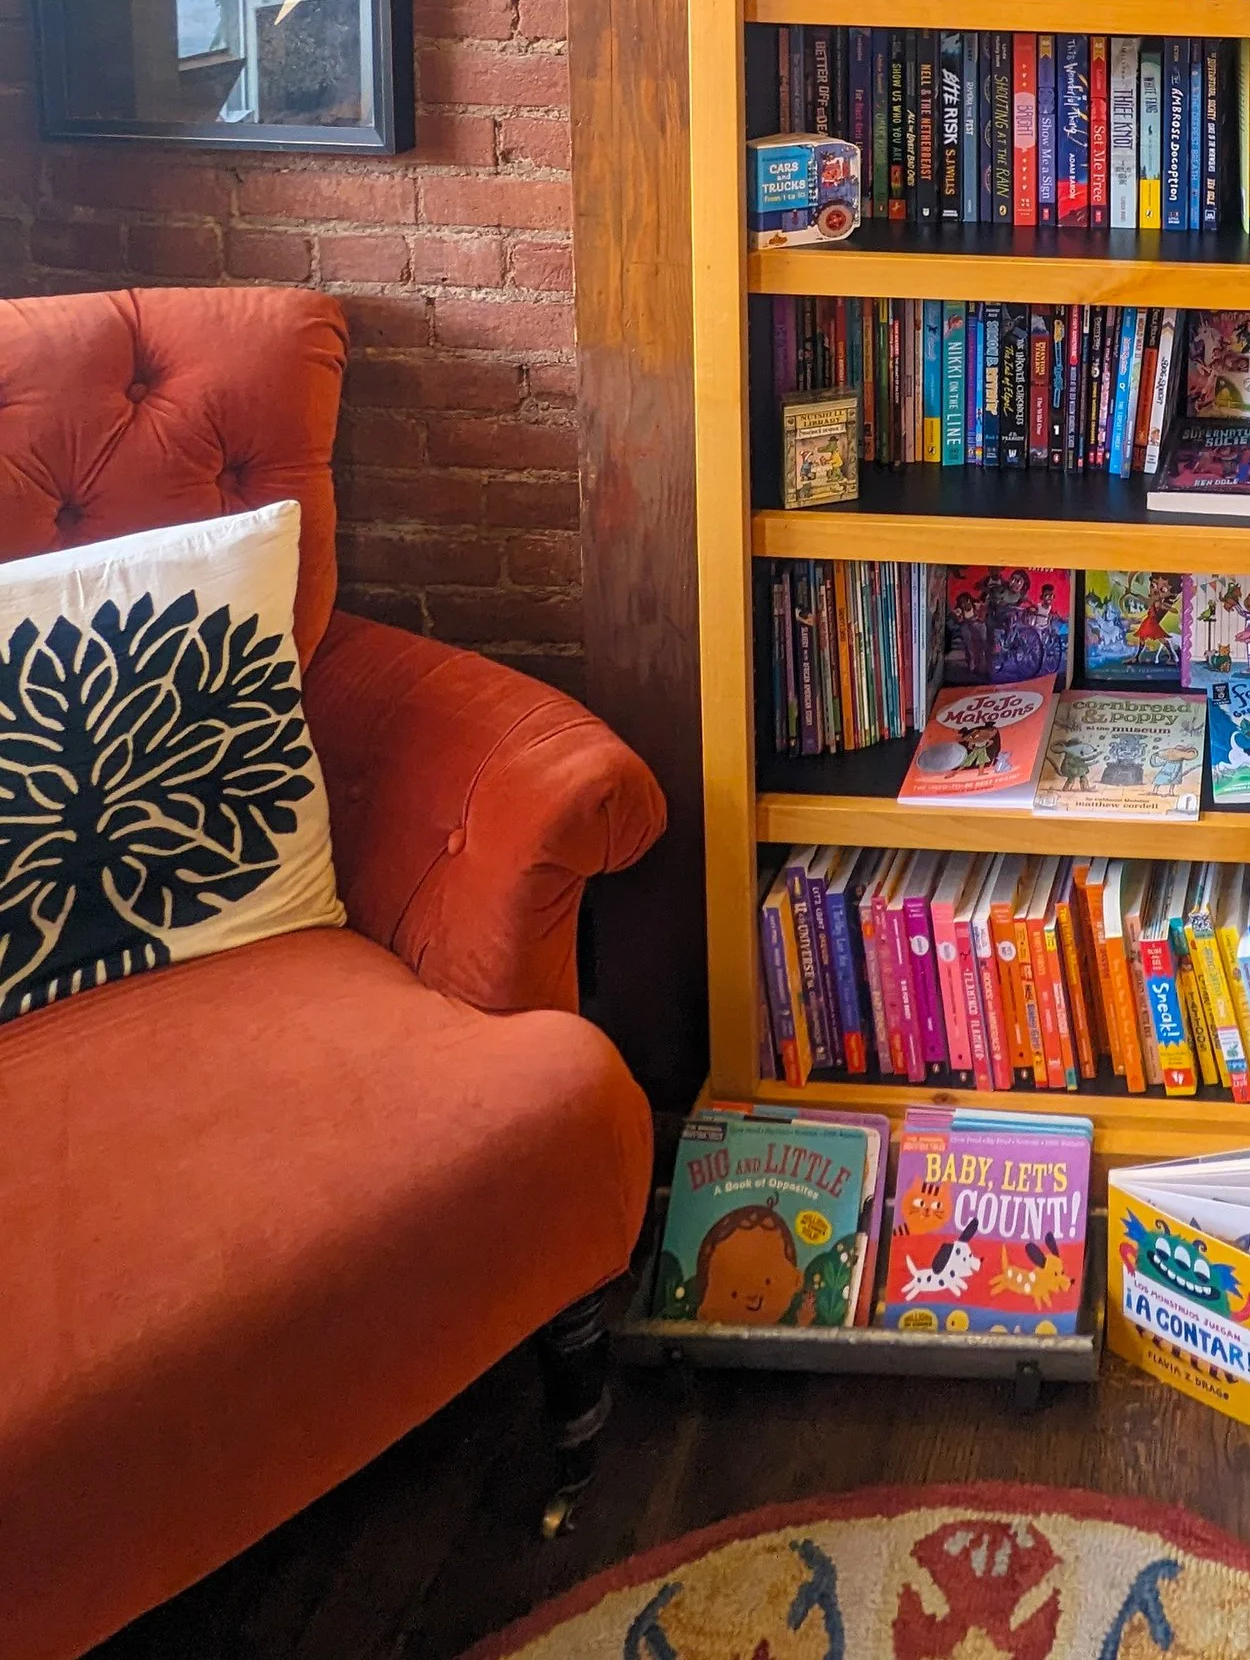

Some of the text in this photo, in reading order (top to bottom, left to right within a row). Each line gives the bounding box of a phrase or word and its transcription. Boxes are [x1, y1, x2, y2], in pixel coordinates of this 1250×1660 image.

[943, 69, 960, 145] BITE RISK
[1017, 105, 1033, 136] BRIGHT
[1113, 89, 1133, 149] THIEF KNOT
[1171, 88, 1183, 139] AMBROSE
[995, 75, 1010, 197] SHOUTING AT THE RAIN
[1041, 117, 1052, 147] Show
[1041, 149, 1052, 164] Me
[762, 180, 805, 193] TRUCKS
[770, 162, 799, 174] CARS
[1040, 175, 1052, 199] Sign
[1094, 125, 1104, 202] Set Me Free
[947, 341, 962, 444] NIKKI ON THE LINE
[1152, 983, 1180, 1038] Sneak!
[688, 1143, 852, 1198] BIG AND LITTLE
[713, 1178, 819, 1199] A Book of Opposites
[926, 1154, 1068, 1192] BABY, LET'S
[955, 1190, 1081, 1239] COUNT!
